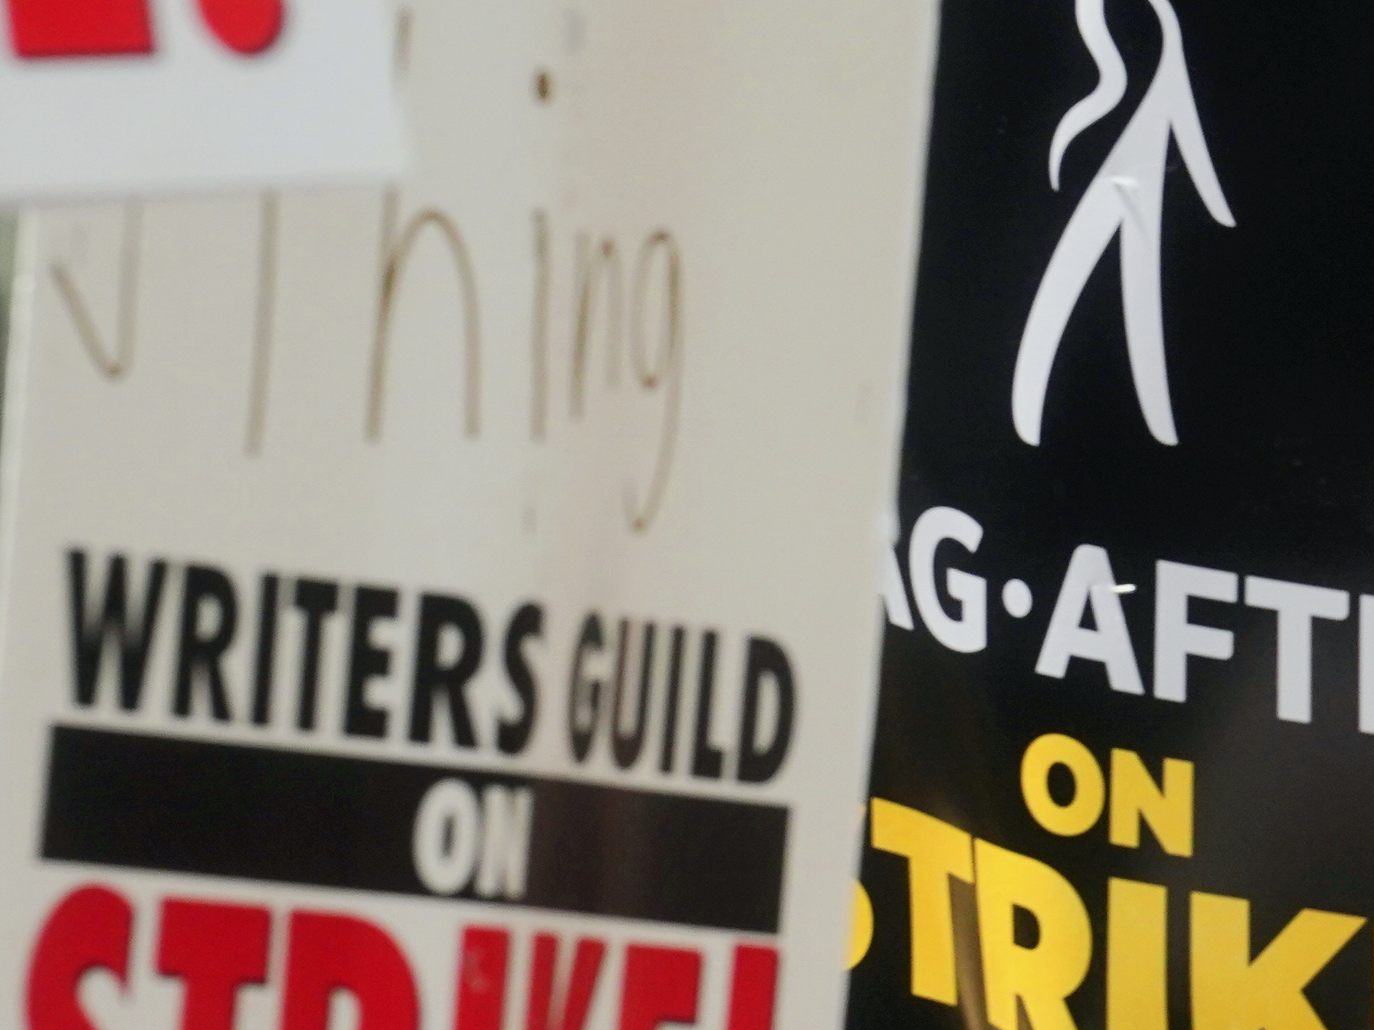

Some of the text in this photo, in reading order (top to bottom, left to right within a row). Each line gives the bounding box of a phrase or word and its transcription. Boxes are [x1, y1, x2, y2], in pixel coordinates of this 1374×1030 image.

[64, 545, 798, 785] WRITERS GUILD
[412, 777, 532, 897] ON
[1020, 733, 1194, 858] ON
